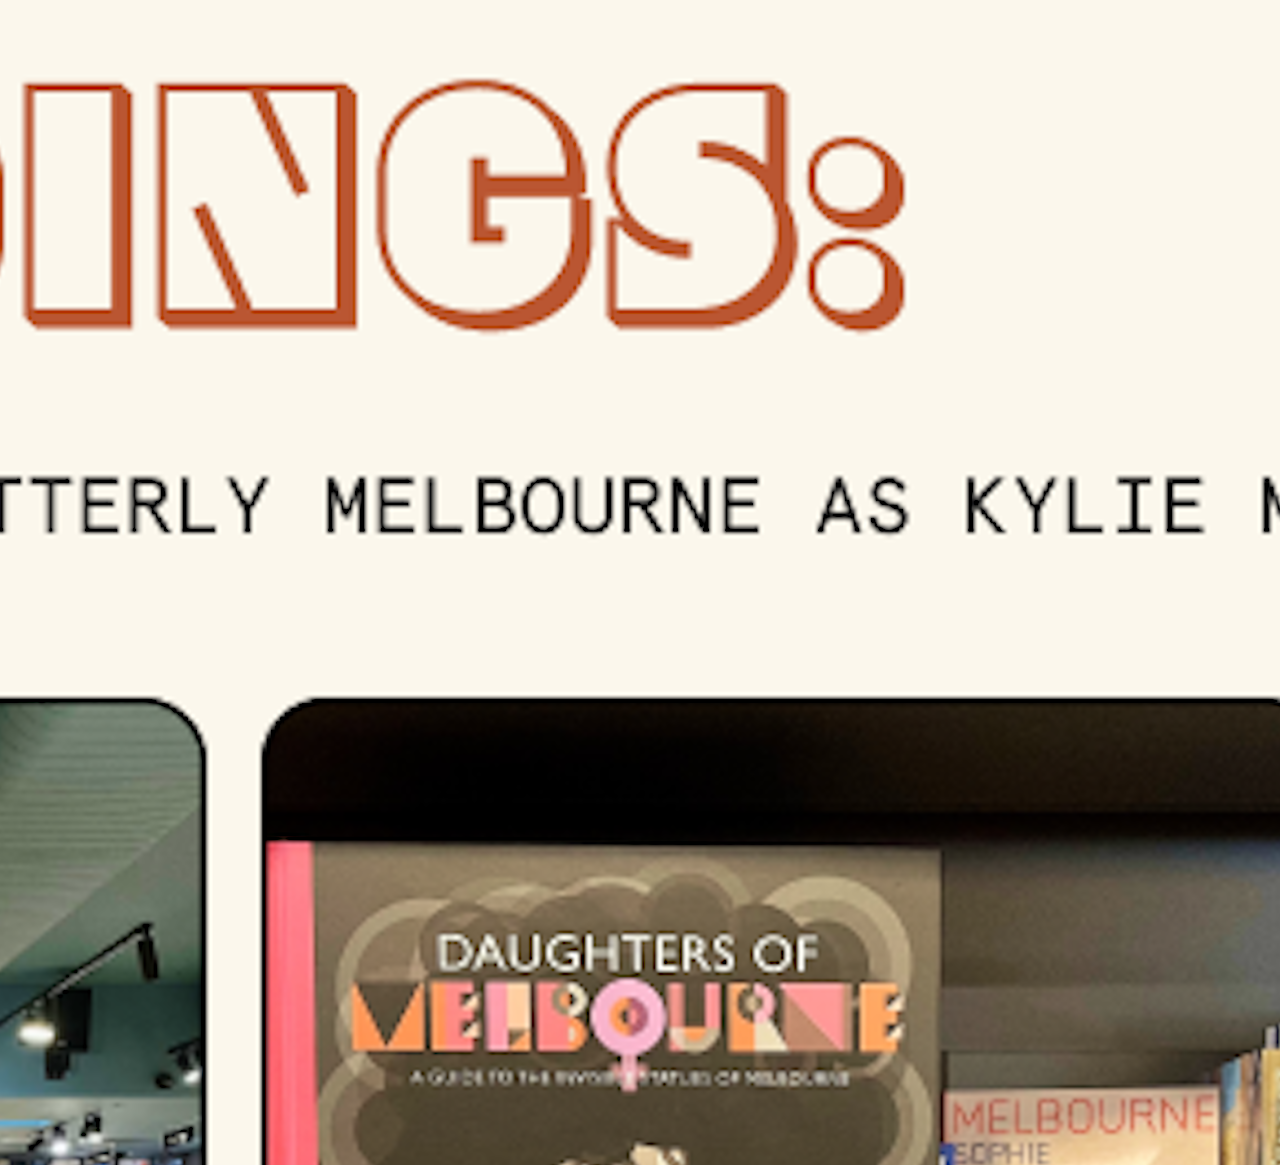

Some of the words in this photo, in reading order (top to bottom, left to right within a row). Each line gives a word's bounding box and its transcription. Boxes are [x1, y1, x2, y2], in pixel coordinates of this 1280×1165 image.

[437, 933, 735, 974] DAUGHTERS
[752, 933, 820, 974] OF
[350, 978, 905, 1054] MELBOURNE
[953, 1094, 1217, 1136] MELBOURNE
